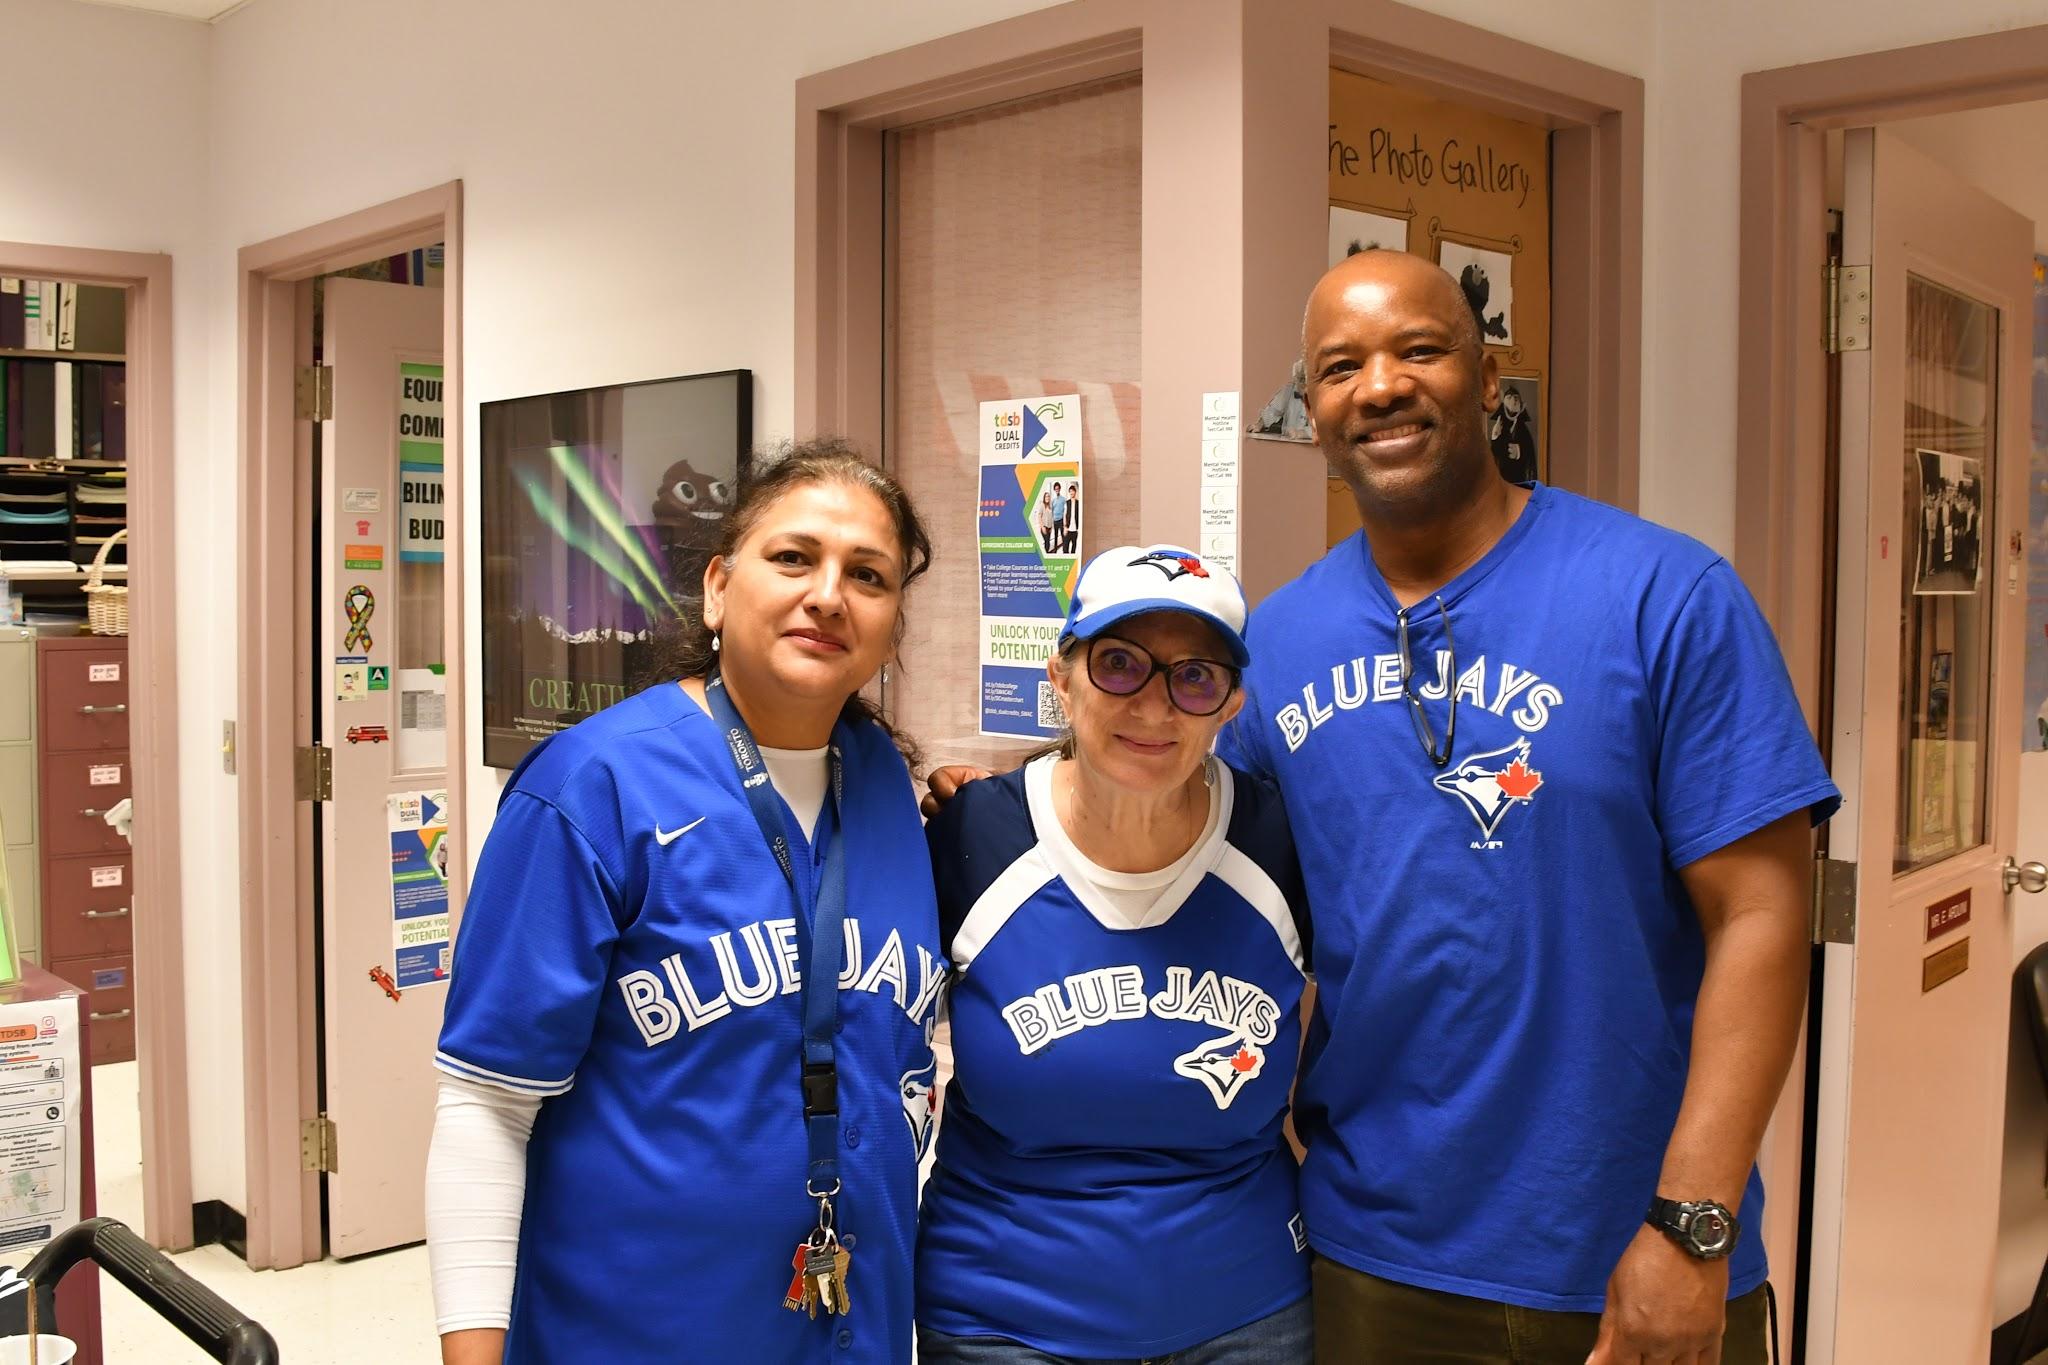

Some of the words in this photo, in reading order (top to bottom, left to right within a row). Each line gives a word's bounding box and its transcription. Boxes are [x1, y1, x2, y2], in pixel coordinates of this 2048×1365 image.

[1370, 128, 1434, 187] Photo
[1441, 139, 1529, 209] Gallery
[404, 377, 443, 403] EQUI
[400, 413, 444, 439] COM
[994, 411, 1021, 428] tdsb
[994, 442, 1020, 450] CREDITS
[995, 430, 1020, 442] DUAL
[403, 482, 444, 504] BILIN
[409, 518, 444, 540] BUD
[990, 624, 1030, 640] UNLOCK
[1275, 654, 1405, 753] BLUE
[1419, 650, 1563, 733] JAYS
[730, 728, 754, 773] TORONTO
[402, 920, 433, 932] UNLOCK
[617, 918, 802, 1048] BLUE
[1003, 965, 1148, 1055] BLUE
[1149, 966, 1281, 1046] JAYS
[1, 1029, 26, 1039] TDSB
